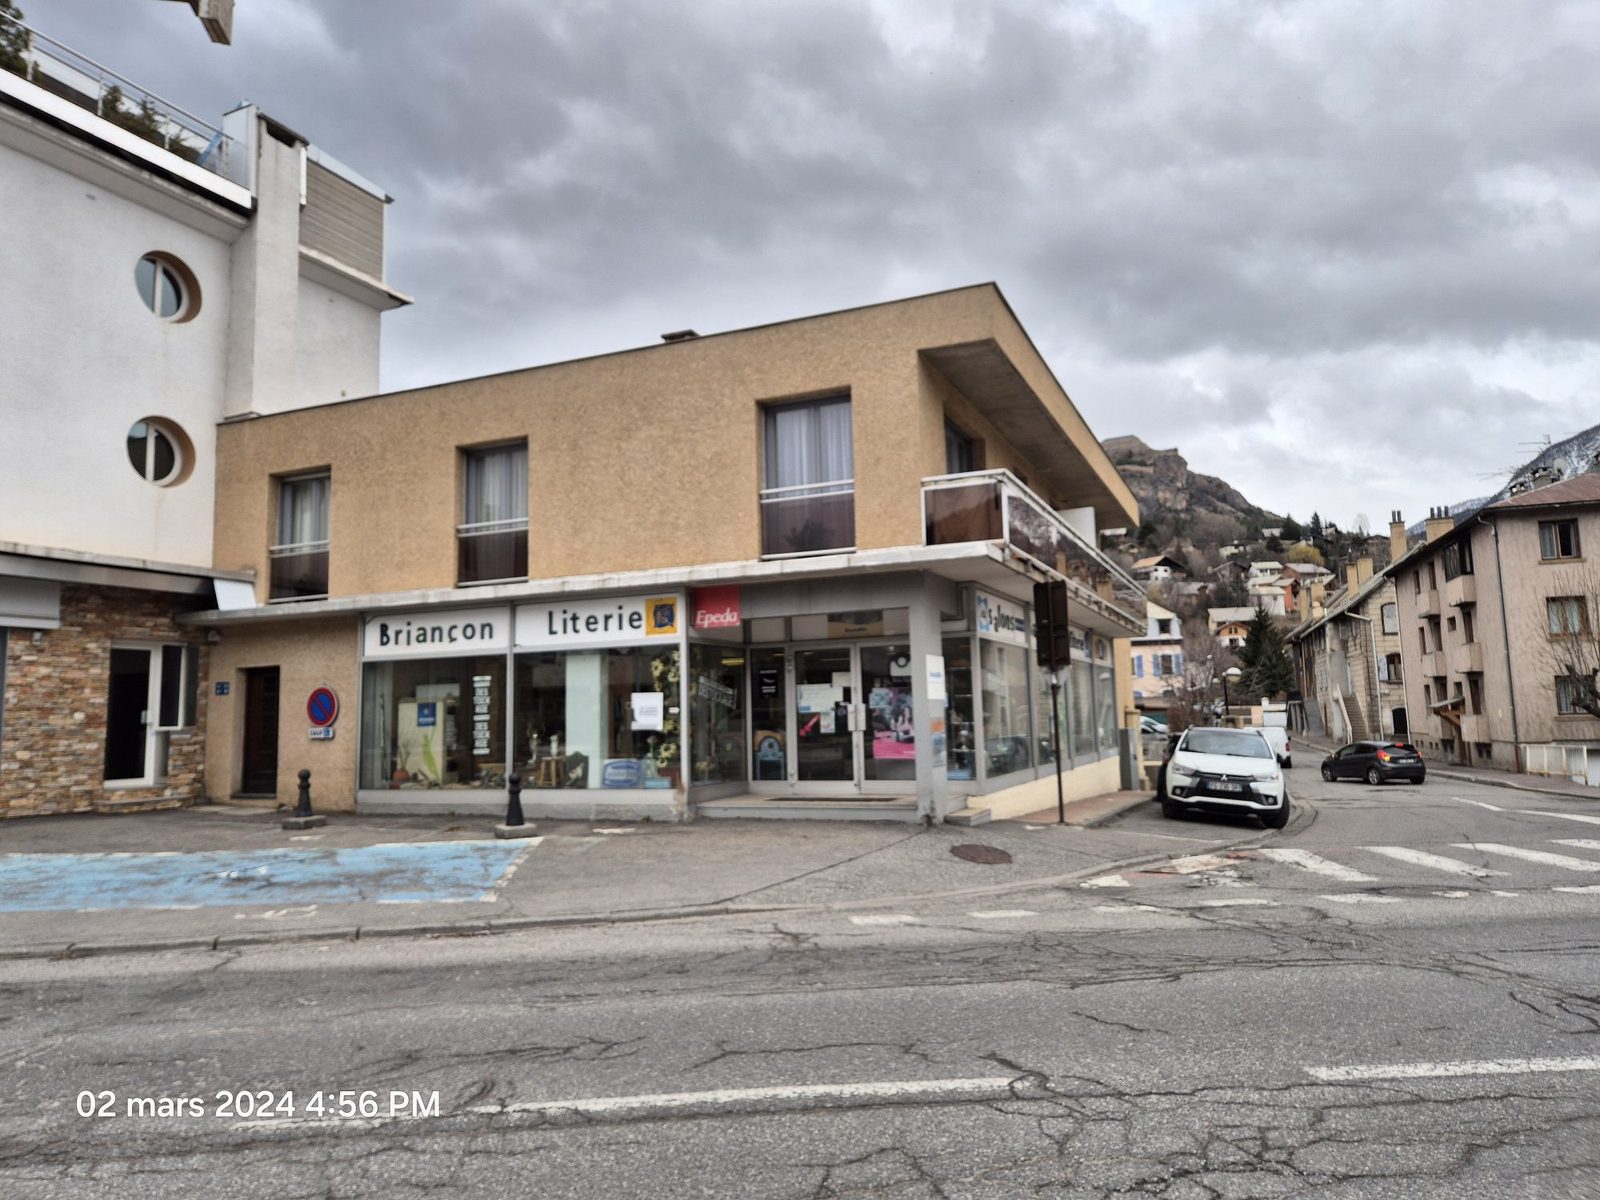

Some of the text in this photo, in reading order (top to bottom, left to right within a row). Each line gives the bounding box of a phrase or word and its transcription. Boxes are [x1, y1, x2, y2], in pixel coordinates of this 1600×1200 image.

[379, 621, 494, 646] Briançon
[548, 605, 643, 635] Literie
[696, 607, 738, 628] Epeda
